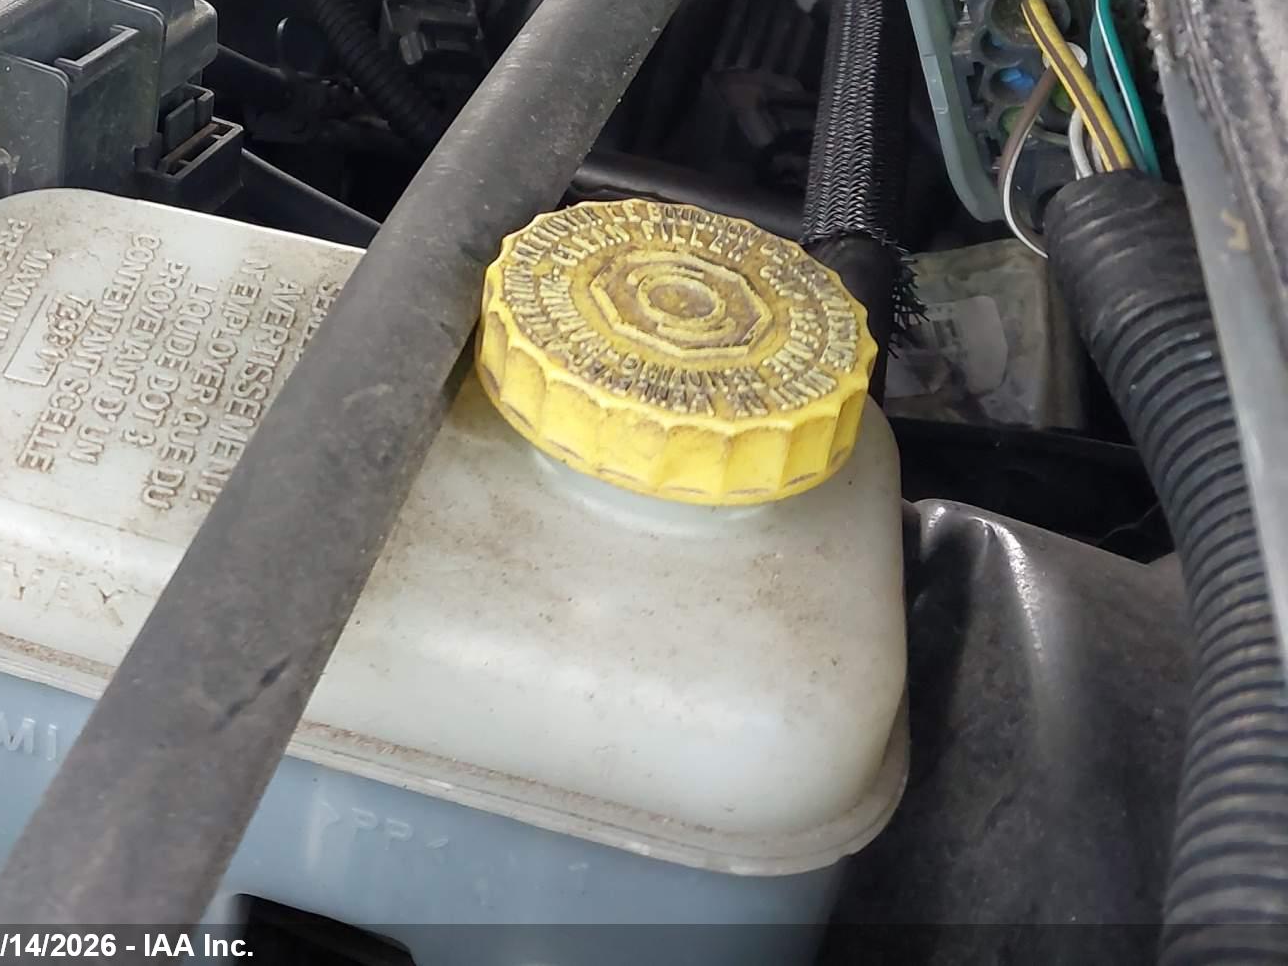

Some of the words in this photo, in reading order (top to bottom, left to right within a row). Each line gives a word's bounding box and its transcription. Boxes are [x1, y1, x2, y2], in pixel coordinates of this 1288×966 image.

[70, 233, 160, 375] CONTENTANT
[103, 257, 188, 396] PROVENANT
[157, 281, 217, 375] LIQUIDE
[187, 280, 259, 406] EMPLOYER
[15, 371, 90, 476] SCELLE
[135, 372, 176, 430] DOT
[160, 406, 210, 470] QUE
[139, 468, 184, 512] DU
